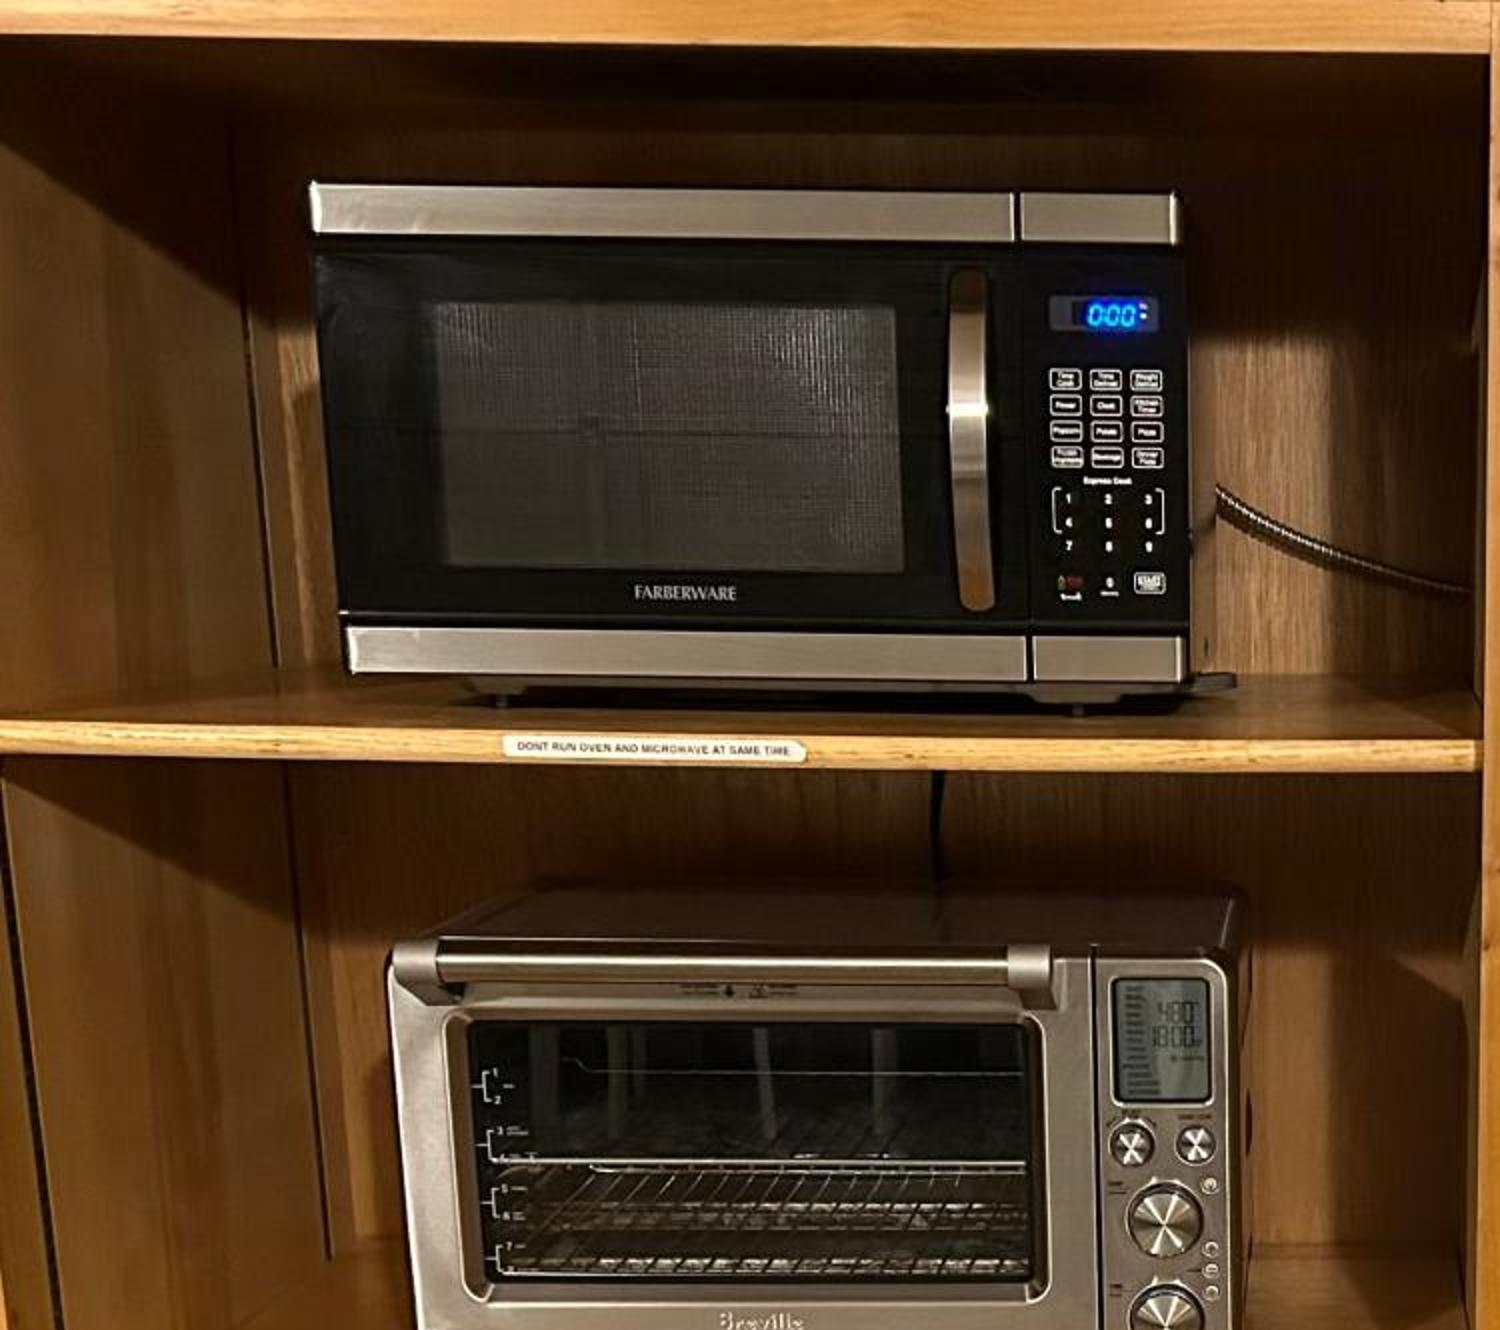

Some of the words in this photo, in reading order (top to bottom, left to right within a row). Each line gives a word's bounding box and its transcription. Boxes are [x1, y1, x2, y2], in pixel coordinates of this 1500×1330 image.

[634, 584, 737, 601] FARBERWARE
[517, 741, 548, 752] DONT
[551, 742, 577, 752] RUN
[579, 743, 612, 754] OVEN
[614, 743, 639, 754] AND
[641, 744, 709, 755] MICROWAVE
[713, 745, 726, 756] AT
[729, 745, 760, 756] SAME
